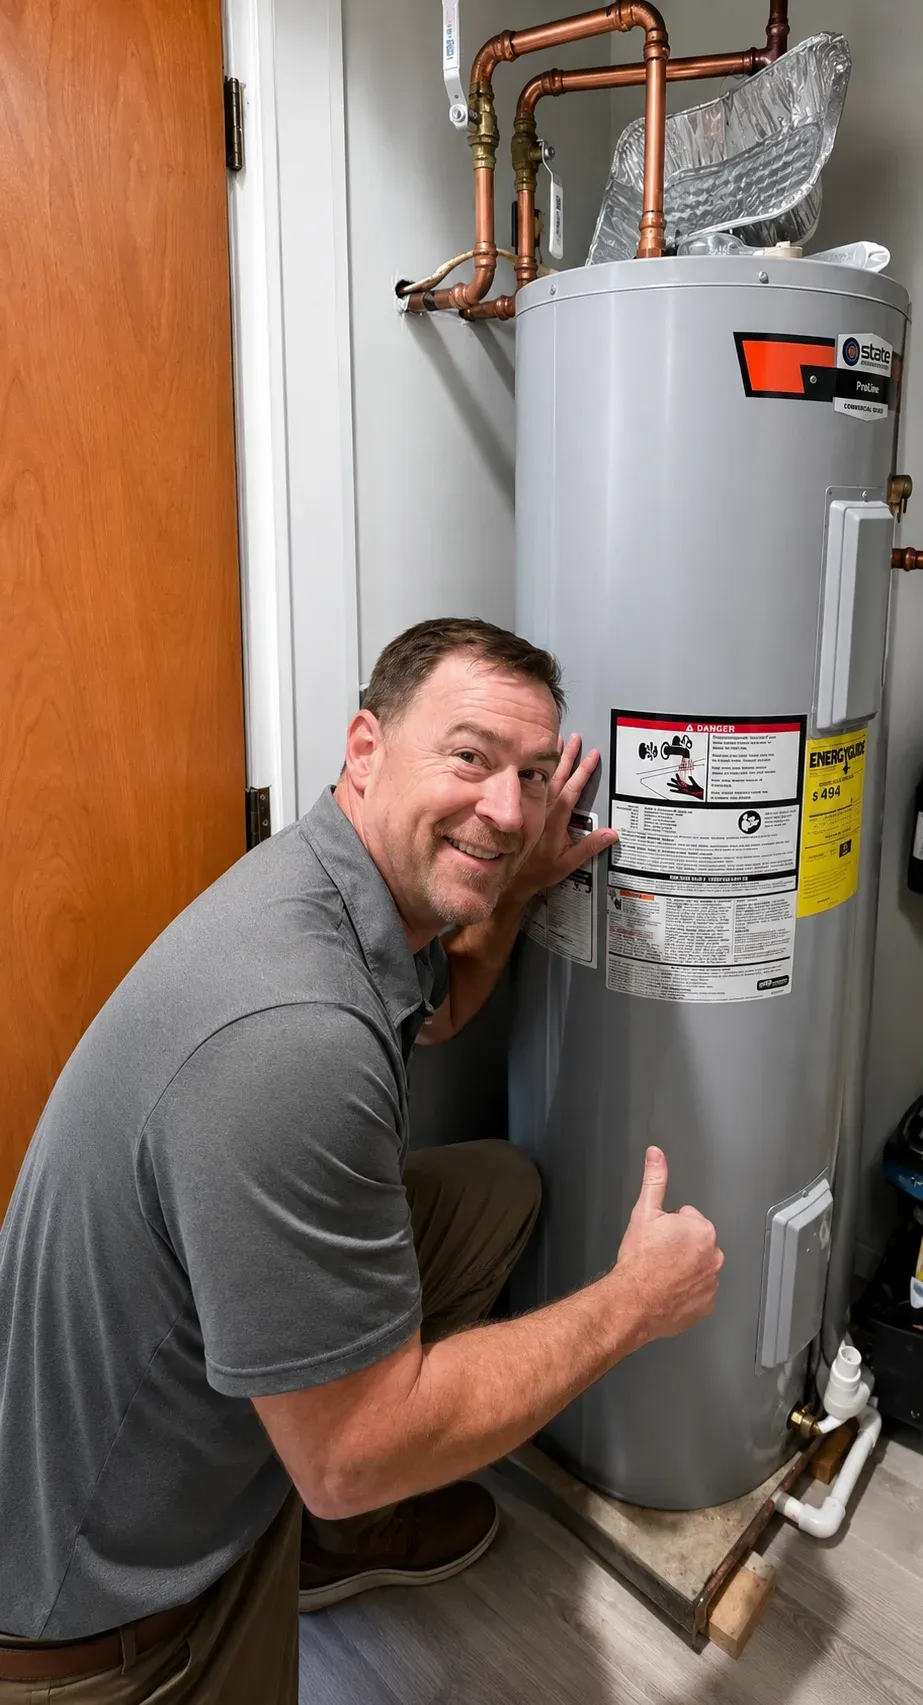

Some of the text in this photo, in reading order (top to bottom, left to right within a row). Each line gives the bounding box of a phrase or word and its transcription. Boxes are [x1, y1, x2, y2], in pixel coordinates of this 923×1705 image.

[861, 344, 890, 364] state
[857, 381, 879, 393] ProLine
[697, 724, 735, 733] DANGER
[810, 740, 865, 769] ENERGYGUIDE
[821, 785, 840, 800] 494
